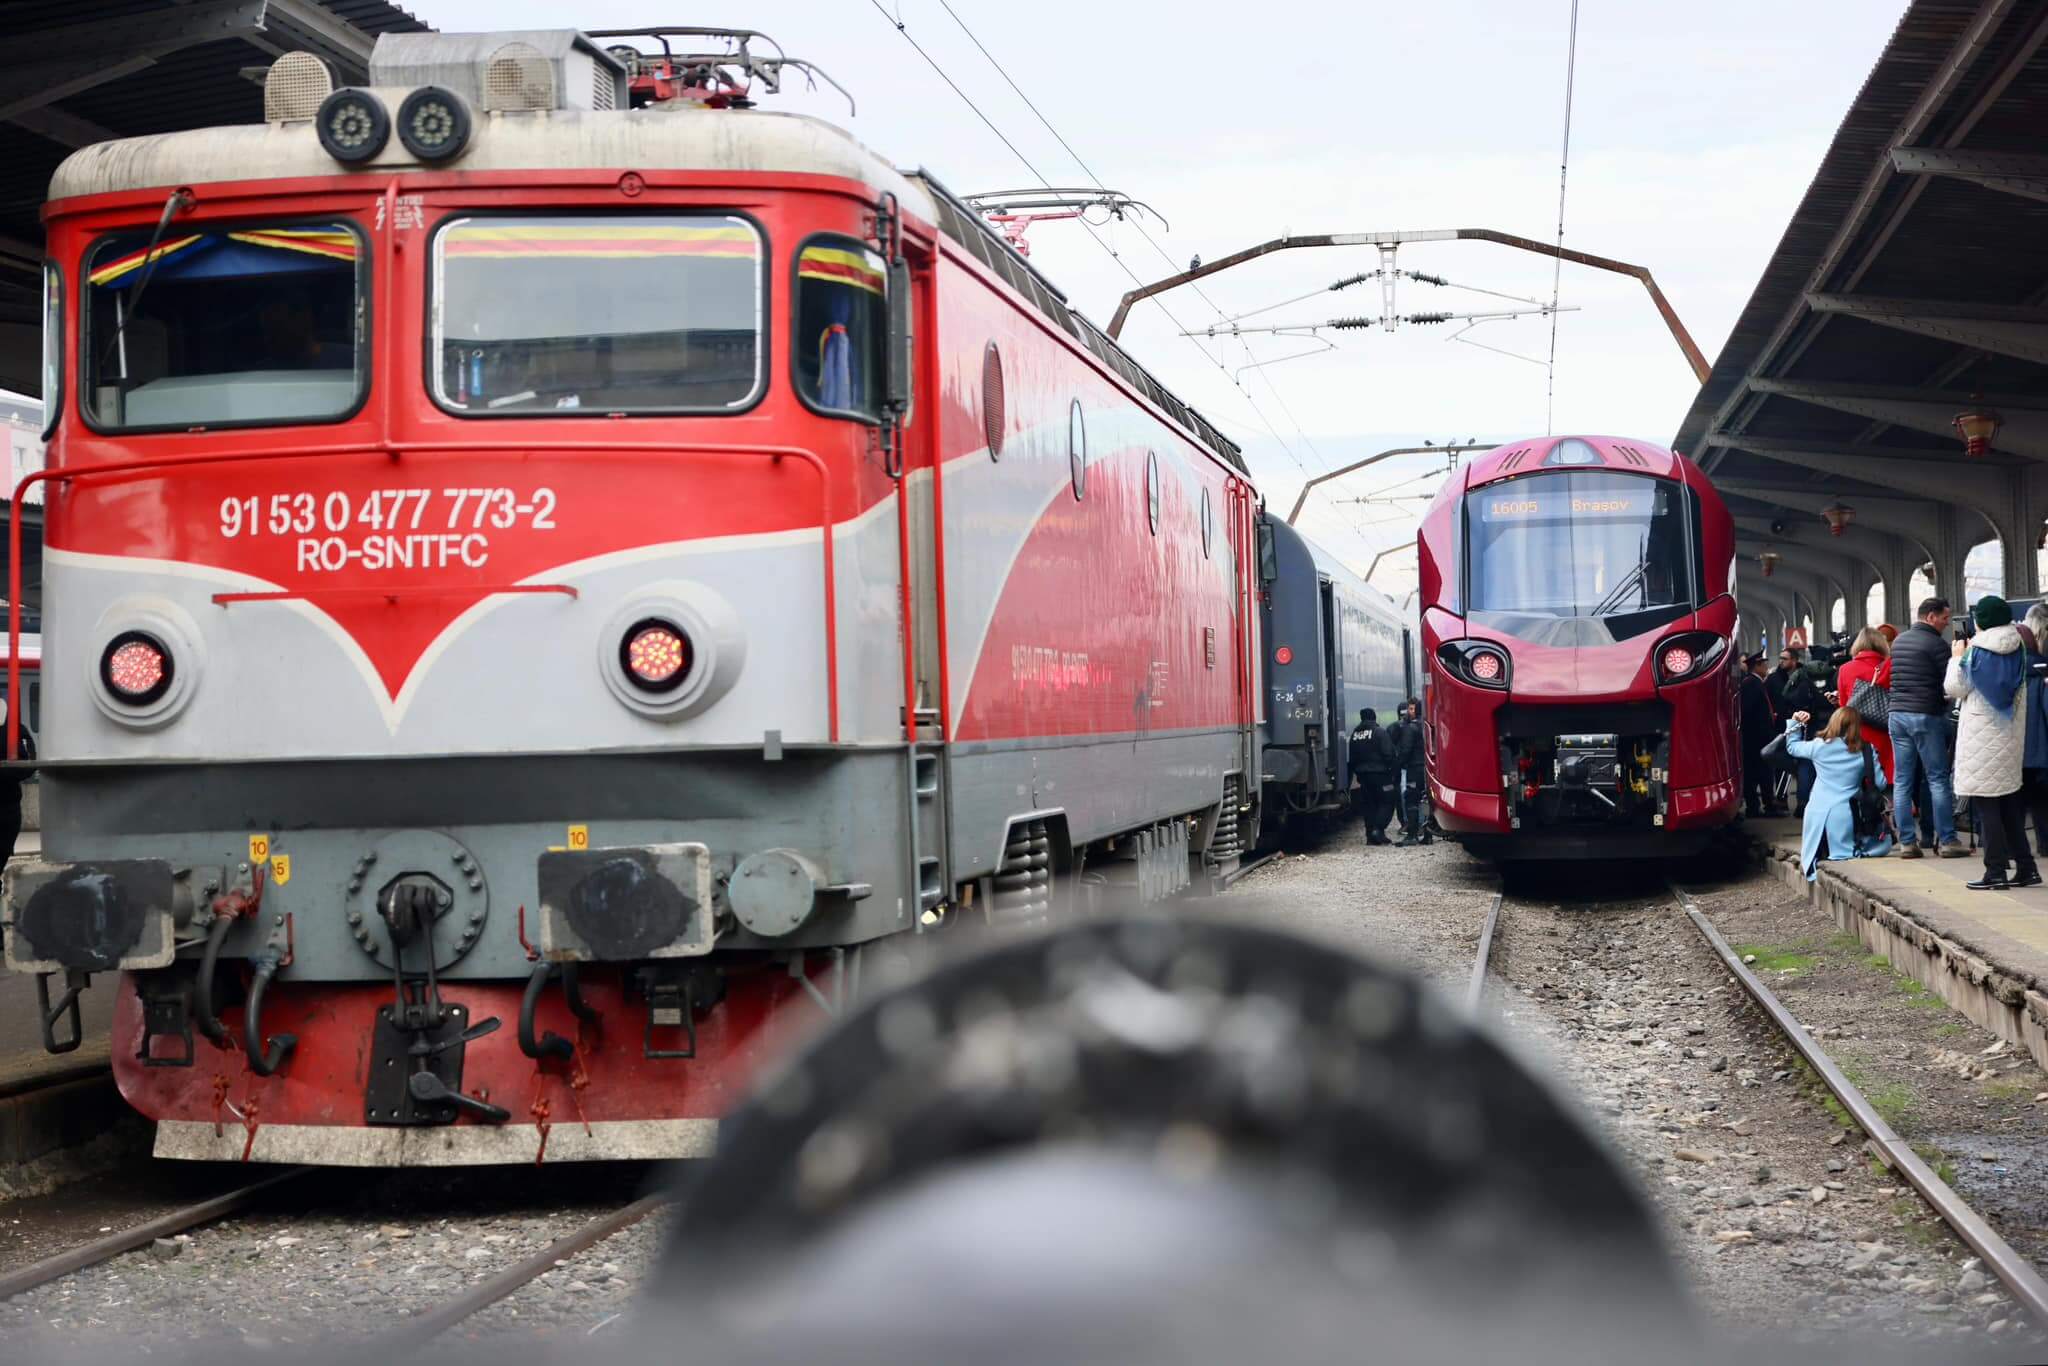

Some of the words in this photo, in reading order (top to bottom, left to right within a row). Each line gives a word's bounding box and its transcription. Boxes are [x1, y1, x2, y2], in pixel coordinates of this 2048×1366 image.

[220, 496, 259, 538] 91
[268, 492, 316, 535] 53
[323, 490, 350, 532] 0
[358, 489, 431, 530] 477
[443, 487, 556, 530] 773-2
[1491, 501, 1538, 514] 16005
[297, 532, 489, 572] RO-SNTFC
[1789, 629, 1804, 646] A
[568, 831, 586, 846] 10
[251, 841, 267, 856] 10
[276, 862, 285, 876] 5
